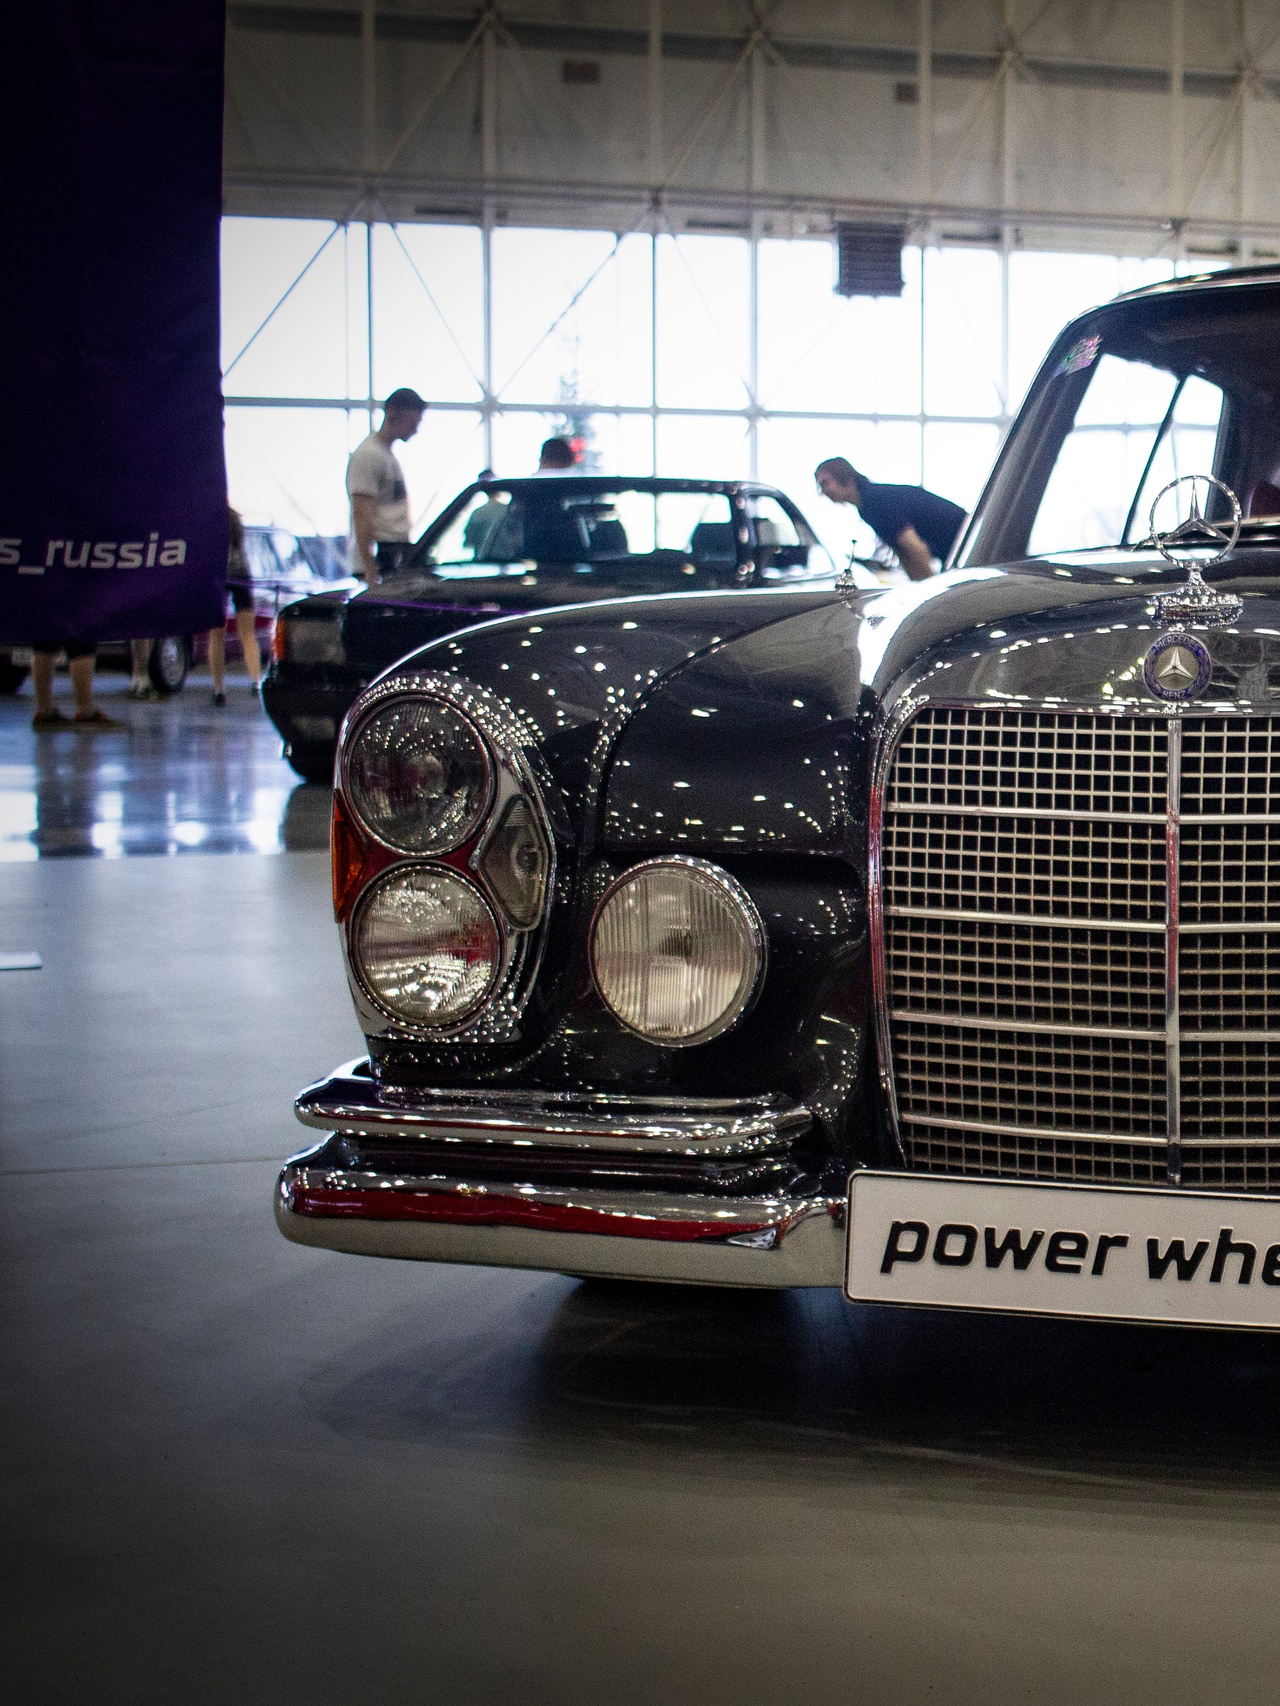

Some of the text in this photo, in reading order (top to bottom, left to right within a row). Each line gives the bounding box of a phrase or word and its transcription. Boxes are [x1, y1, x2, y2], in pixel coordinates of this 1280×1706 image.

[1154, 634, 1201, 651] MERCEDES
[1162, 689, 1188, 699] BENZ
[879, 1220, 1129, 1274] power
